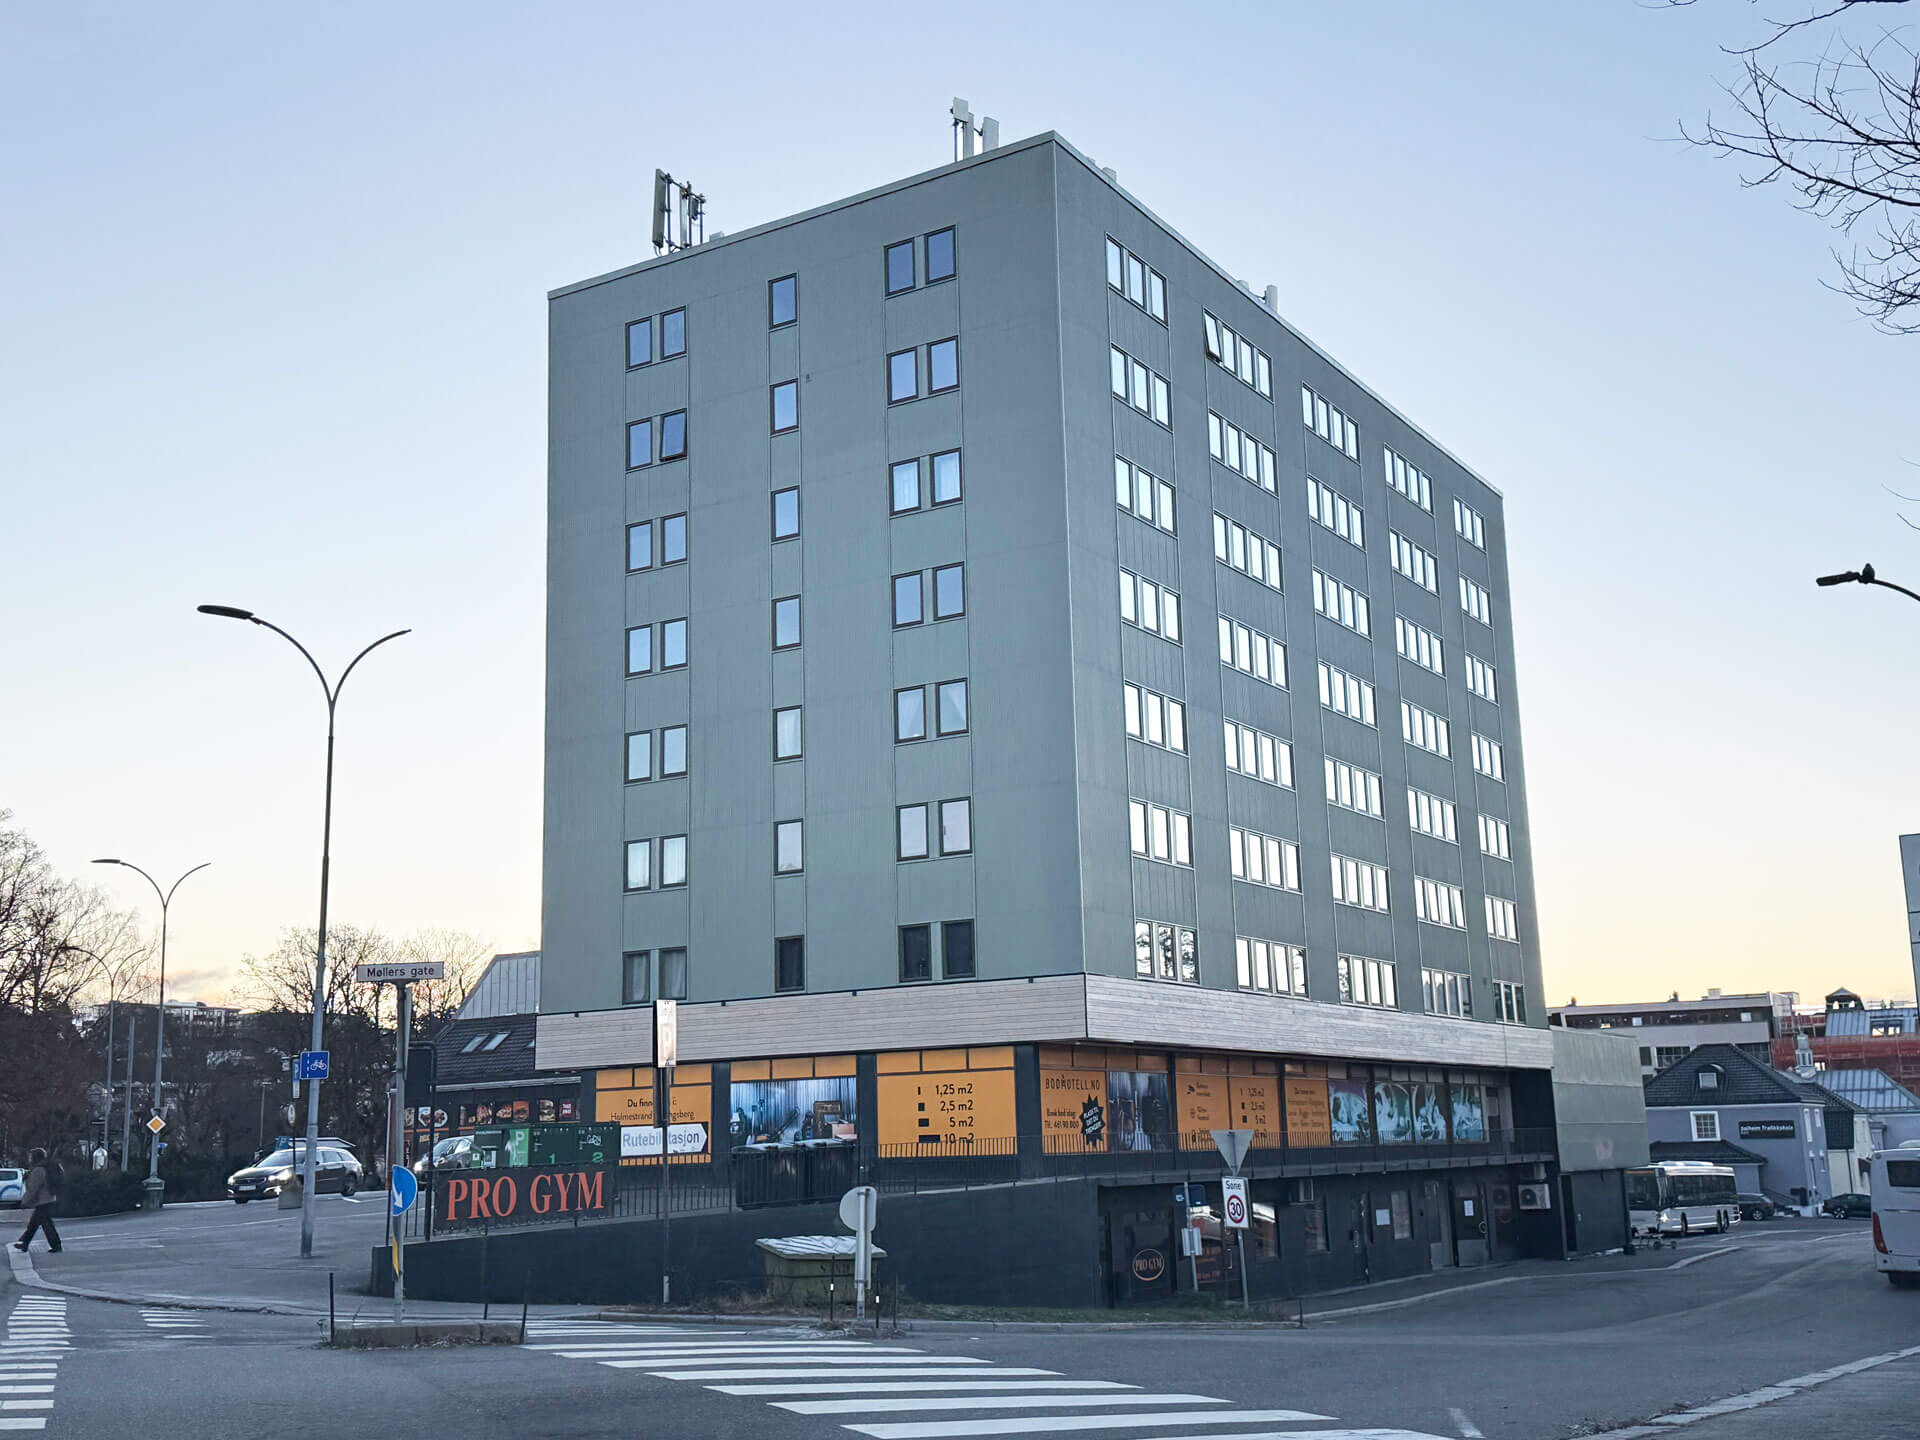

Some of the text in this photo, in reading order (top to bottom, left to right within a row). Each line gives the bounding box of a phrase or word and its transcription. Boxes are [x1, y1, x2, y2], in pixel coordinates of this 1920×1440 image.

[367, 966, 435, 978] Møllers gate
[936, 1083, 973, 1096] 1,25 m2
[627, 1099, 638, 1108] Du
[940, 1099, 974, 1113] 2,5 m2
[610, 1111, 653, 1120] Holmestrand
[949, 1116, 974, 1128] 5 m2
[622, 1130, 700, 1148] Rutebiltasjon
[944, 1132, 974, 1144] 10 m2
[1225, 1180, 1241, 1190] Sone
[446, 1171, 605, 1220] PRO GYM
[1230, 1202, 1241, 1217] 30
[1135, 1258, 1147, 1271] PRO
